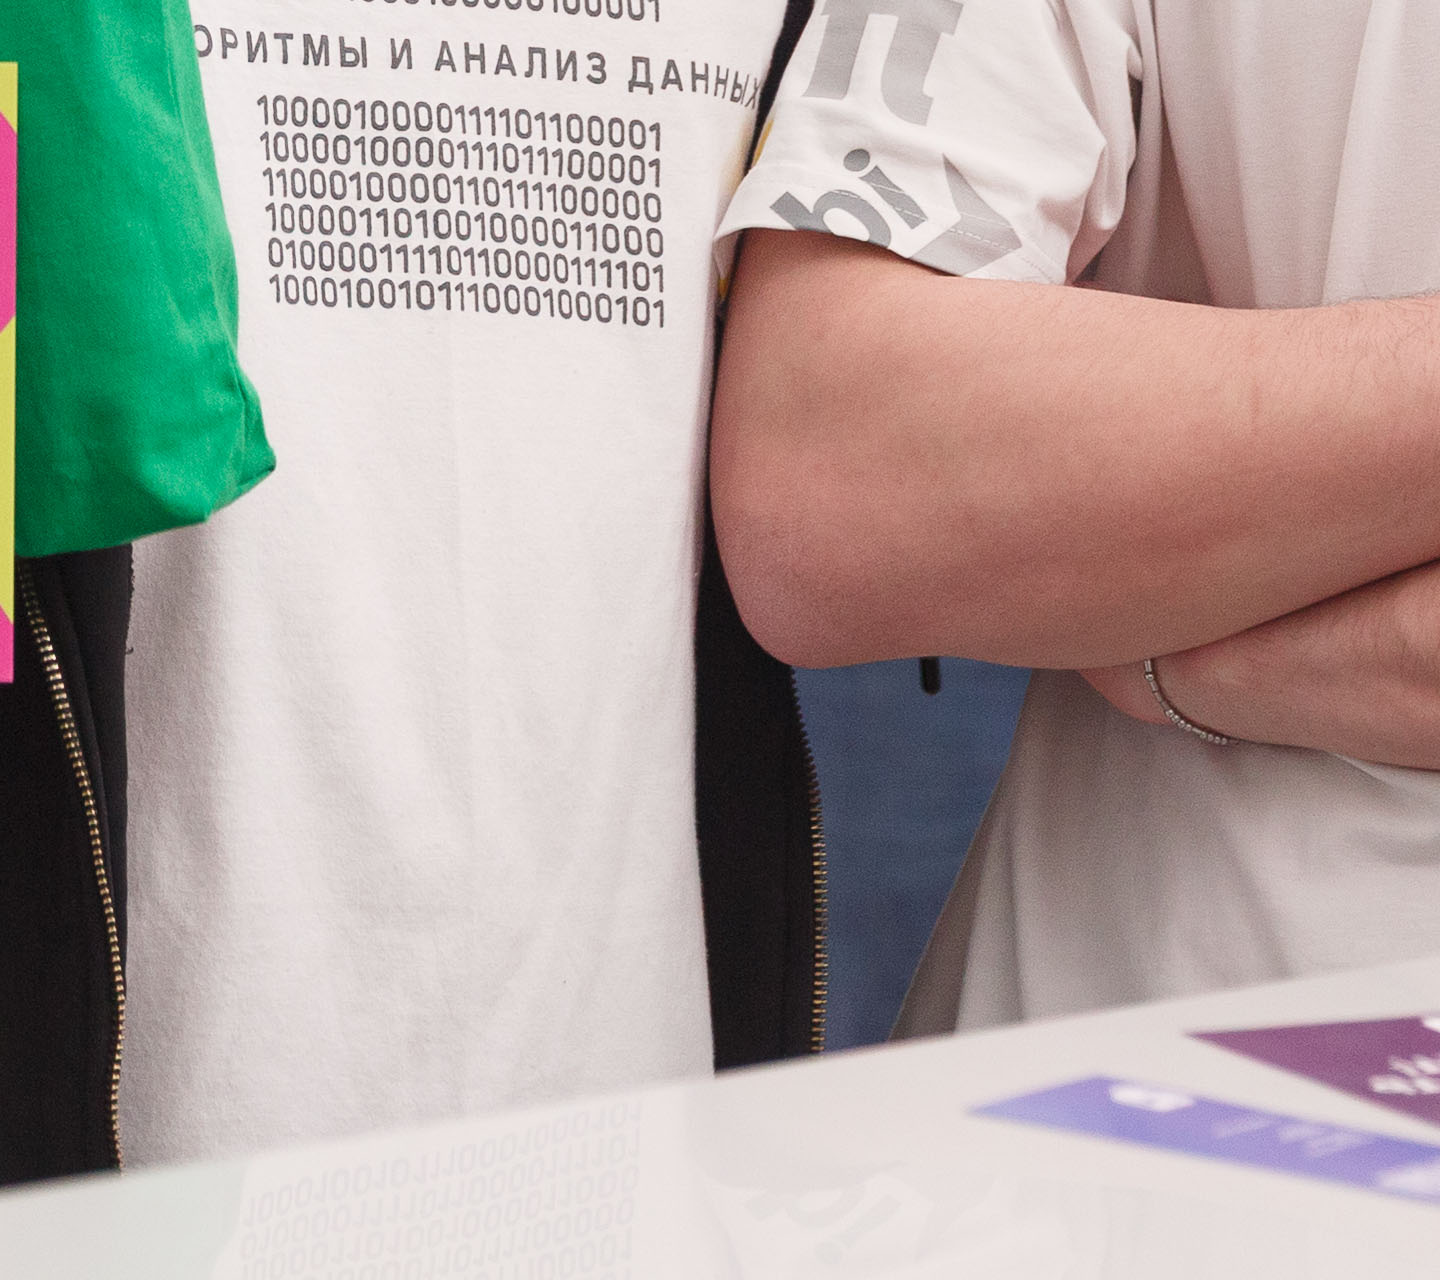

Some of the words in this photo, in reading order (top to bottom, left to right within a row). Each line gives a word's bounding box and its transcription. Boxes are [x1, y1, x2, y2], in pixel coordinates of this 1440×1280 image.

[390, 38, 413, 70] И
[435, 40, 607, 85] АНАЛИЗ
[257, 95, 660, 152] 1000010000111101100001
[260, 132, 660, 188] 1000010000111011100001
[263, 168, 661, 222] 1100010000110111100000
[265, 202, 663, 258] 100001101001000011000
[268, 238, 664, 292] 01000011110110000111101
[270, 274, 664, 328] 1000100101110001000101
